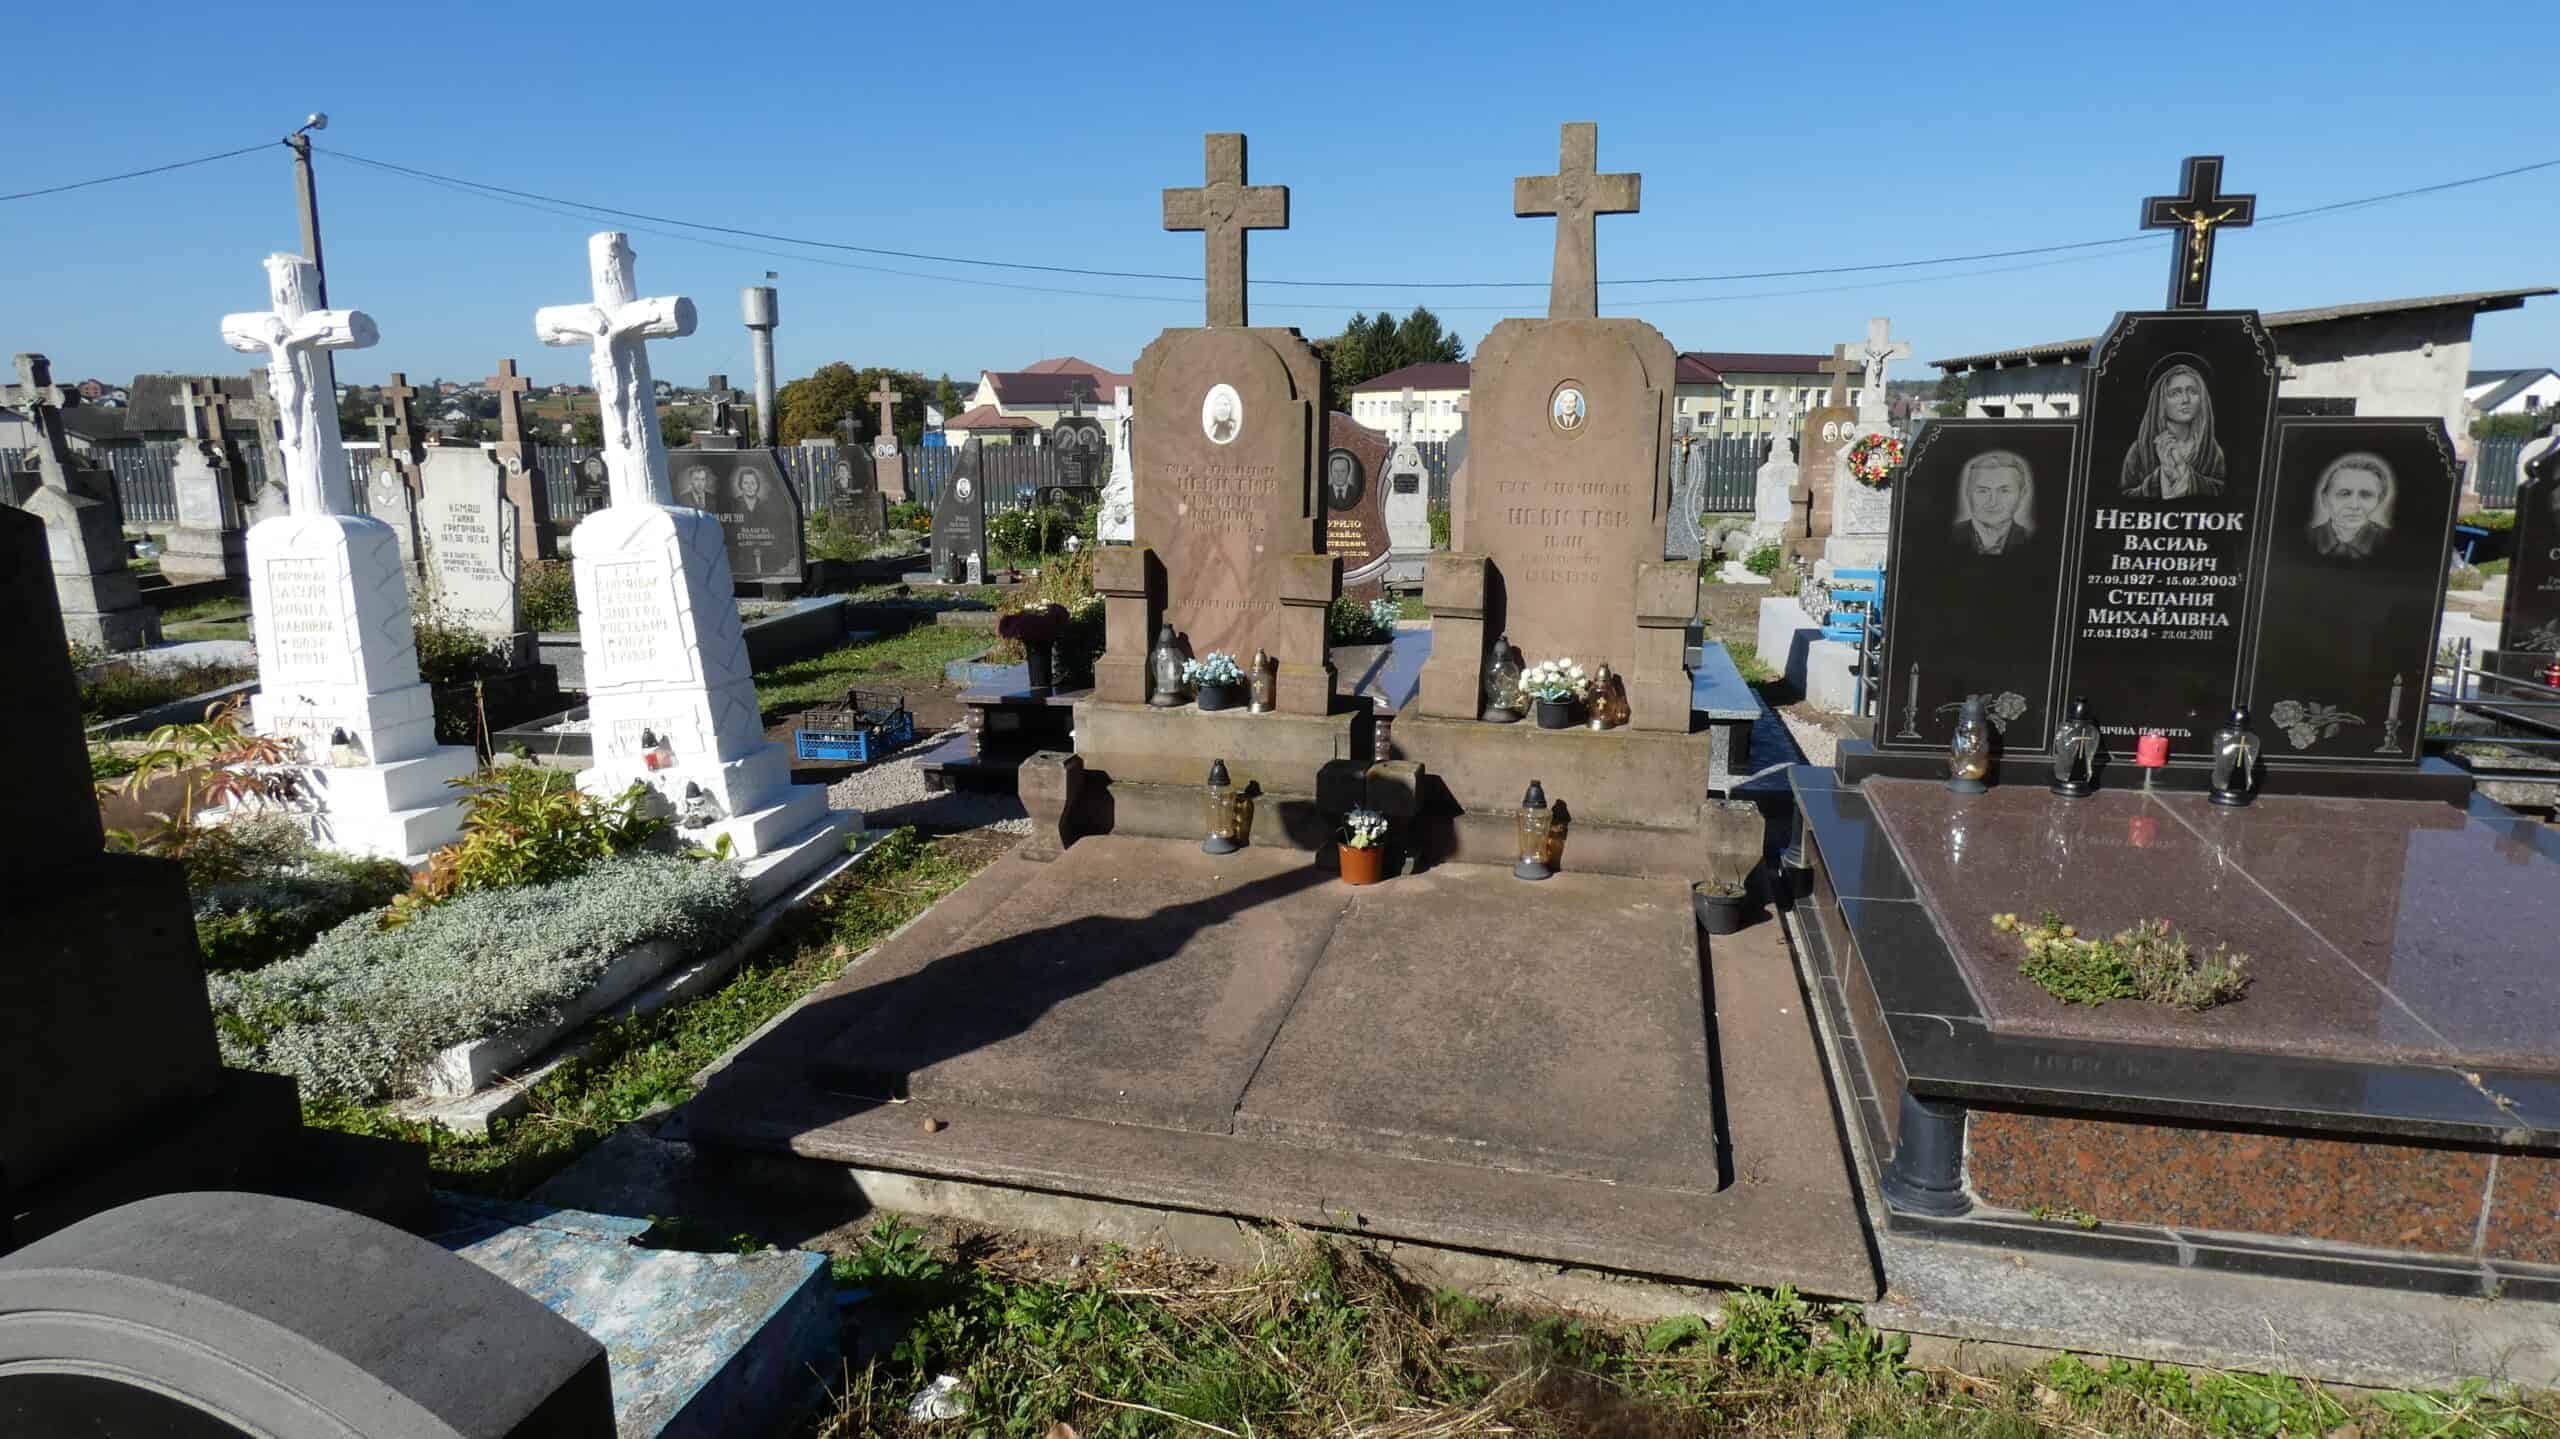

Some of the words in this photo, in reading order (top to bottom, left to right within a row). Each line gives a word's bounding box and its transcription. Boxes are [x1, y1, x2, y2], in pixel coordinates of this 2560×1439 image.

[1327, 520, 1361, 528] УРИЛО
[2095, 509, 2245, 531] НЕВІСТЮК
[2123, 534, 2209, 551] ВАСИЛЬ
[2111, 554, 2218, 572] ІВАНОВИЧ
[2087, 574, 2155, 585] 27.09.1927
[2165, 575, 2238, 587] 15.02.2003
[2108, 589, 2216, 607] СТЕПАНІЯ
[2087, 606, 2230, 627] МИХАЙЛІВНА
[2082, 628, 2149, 639] 17.03.1934
[2161, 629, 2214, 641] 23.01.2011
